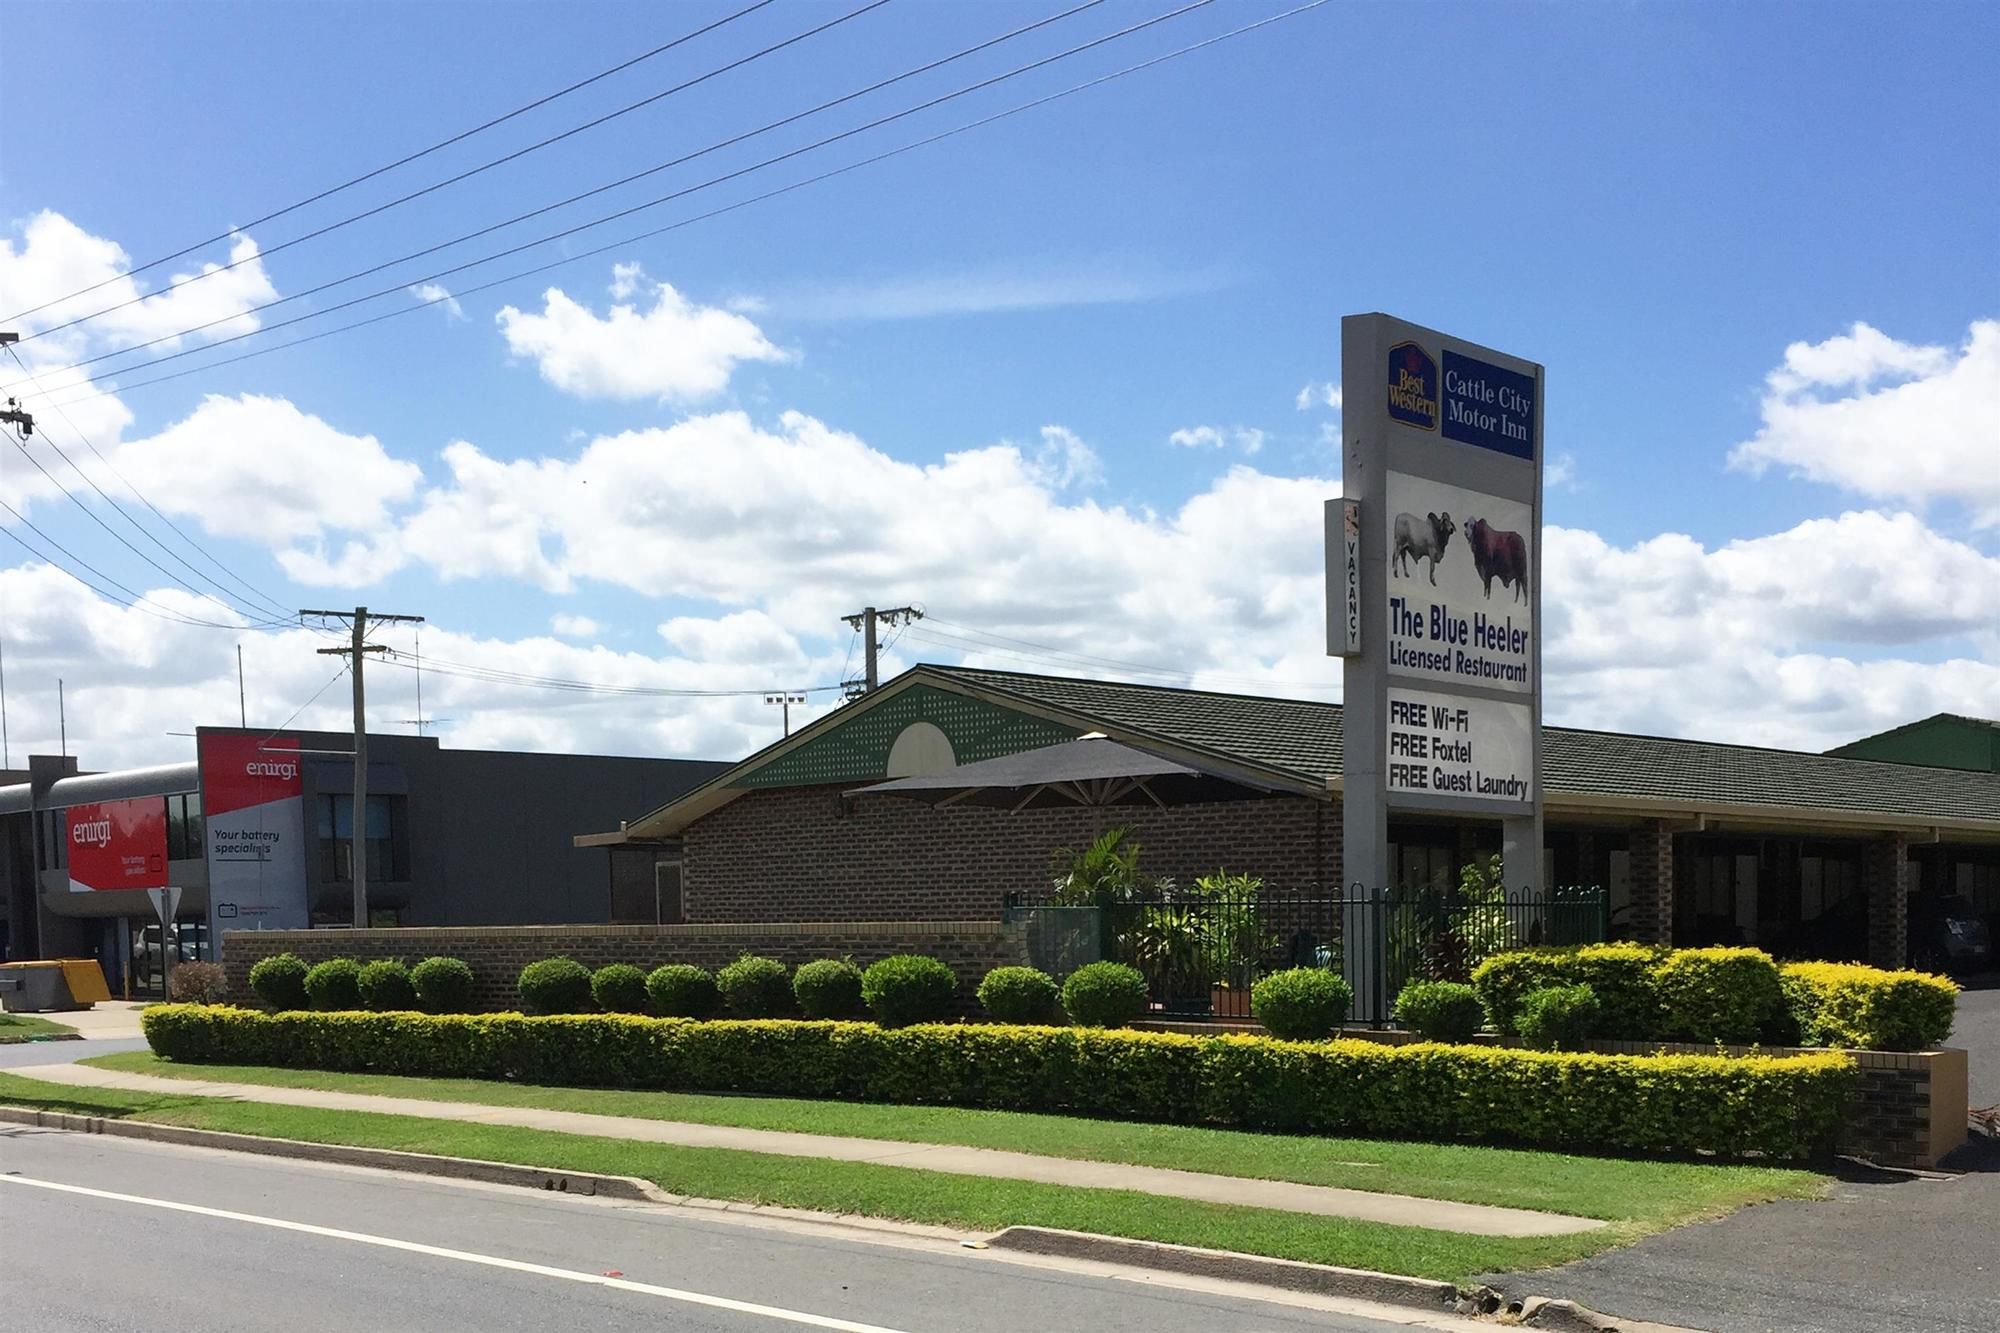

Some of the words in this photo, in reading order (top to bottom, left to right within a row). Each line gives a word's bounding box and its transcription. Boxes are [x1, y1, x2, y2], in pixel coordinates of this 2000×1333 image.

[1400, 368, 1424, 396] Best
[1446, 370, 1495, 404] Cattle
[1499, 386, 1531, 417] City
[1388, 384, 1436, 417] Western
[1449, 399, 1497, 432] Motor
[1502, 414, 1527, 440] Inn
[1348, 541, 1357, 645] VACANCY
[1390, 597, 1424, 639] The
[1430, 604, 1468, 645] Blue
[1474, 612, 1528, 654] Heeler
[1390, 641, 1451, 672] Licensed
[1456, 650, 1527, 682] Restaurant
[1391, 701, 1427, 727] FREE
[1432, 706, 1468, 733] Wi-Fi
[1391, 732, 1427, 758] FREE
[1432, 737, 1471, 763] Foxtel
[246, 760, 297, 780] enirgi
[1390, 764, 1428, 788] FREE
[1433, 767, 1472, 792] Guest
[1476, 771, 1528, 801] Laundry
[73, 814, 111, 848] enirgi
[215, 829, 239, 840] Your
[241, 829, 280, 843] battery
